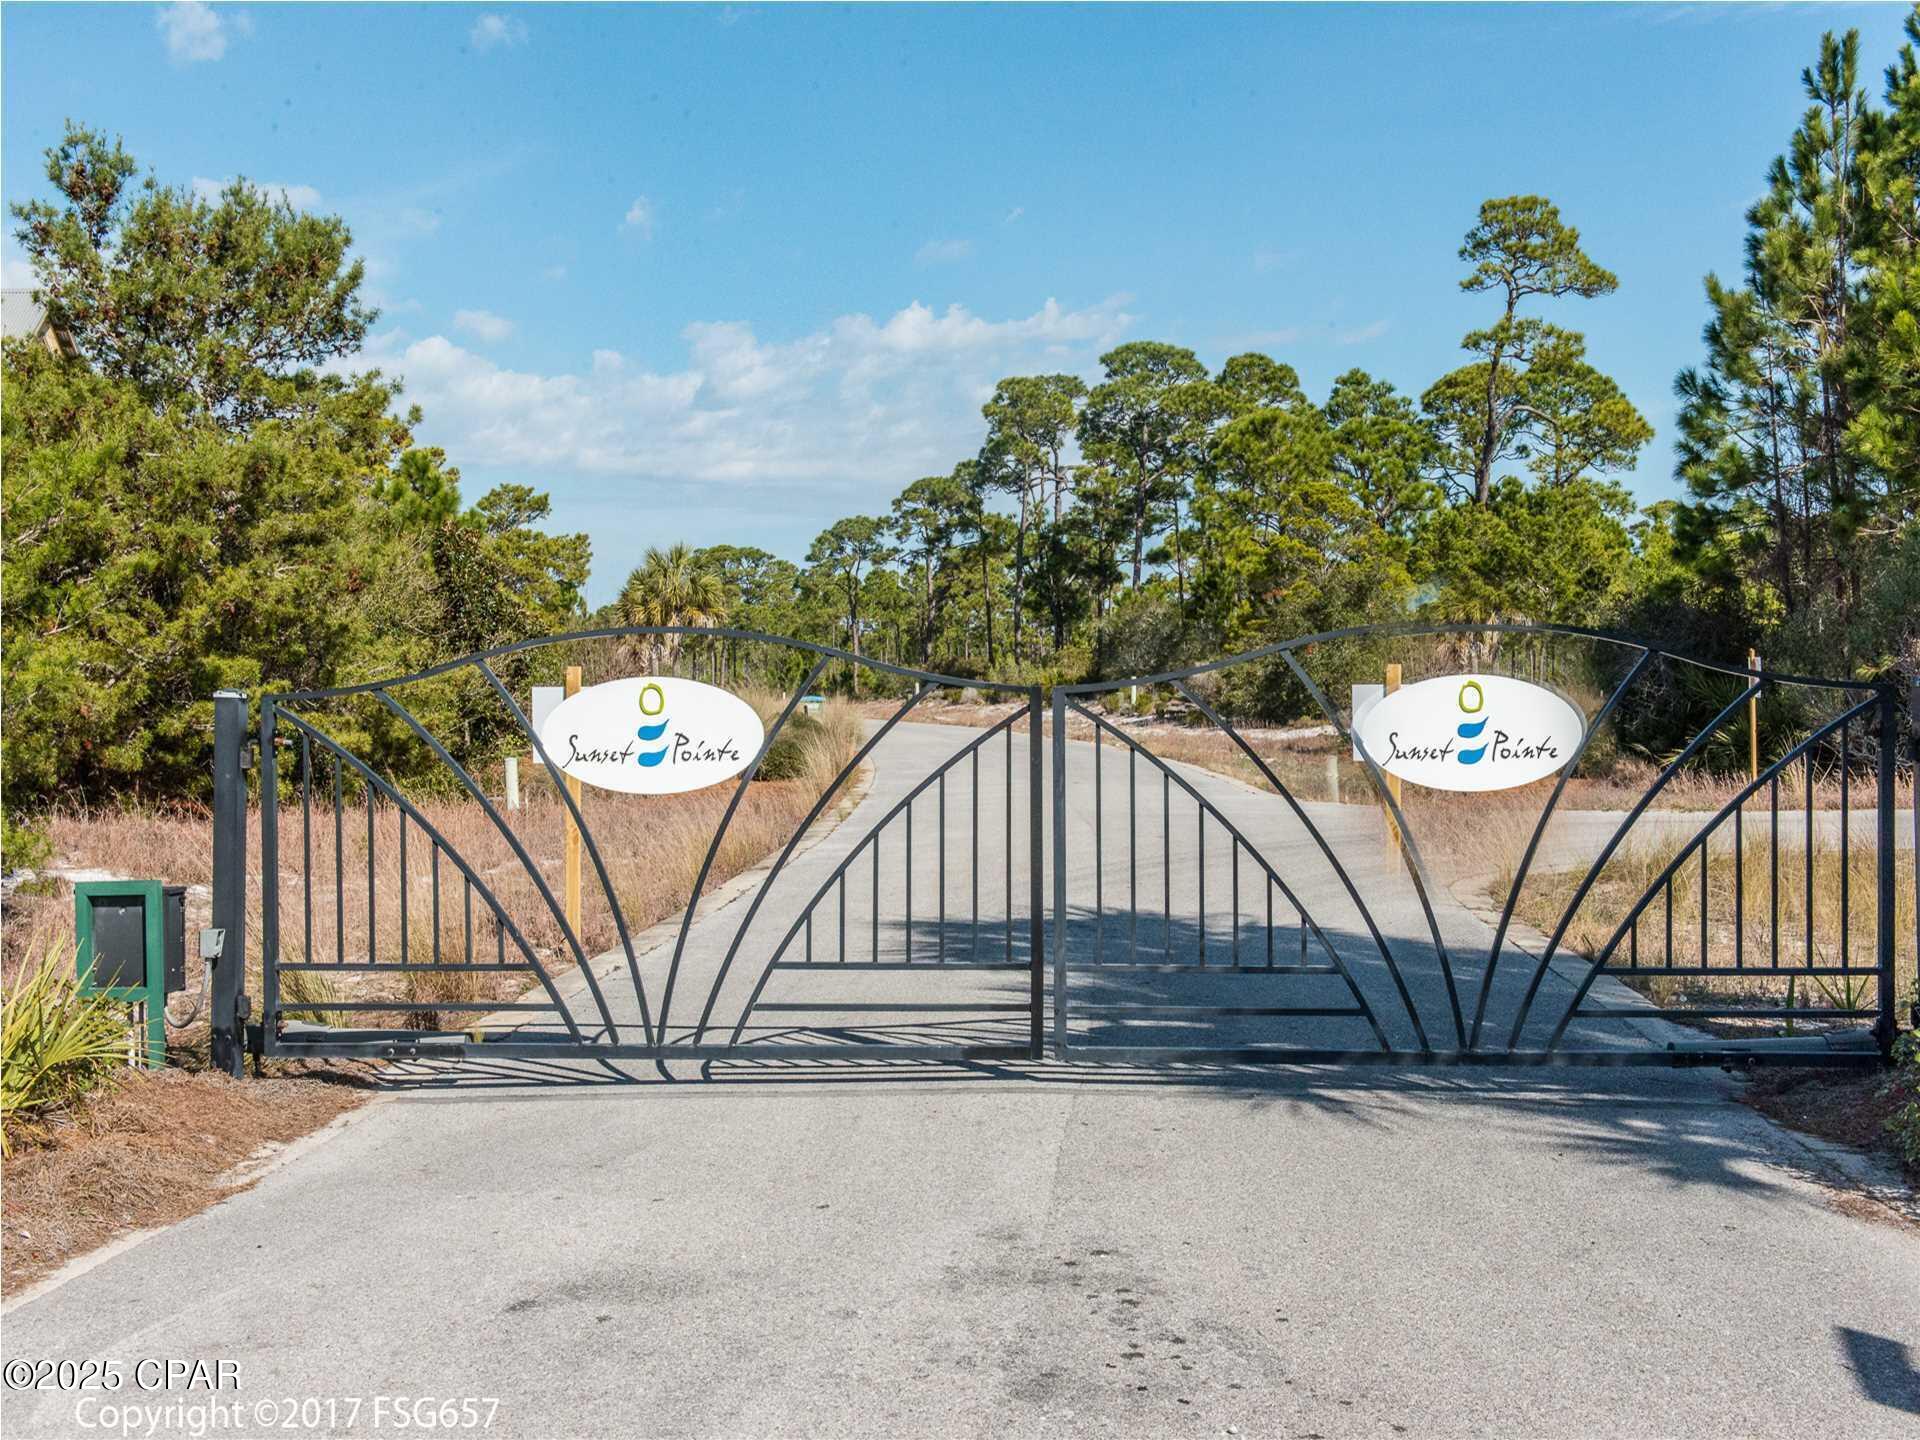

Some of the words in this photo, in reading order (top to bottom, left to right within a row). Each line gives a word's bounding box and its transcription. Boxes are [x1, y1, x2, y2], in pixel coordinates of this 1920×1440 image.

[562, 734, 634, 769] Sunset
[672, 732, 741, 765] Pointe
[1382, 731, 1455, 766] Sunset
[1491, 730, 1559, 762] Pointe
